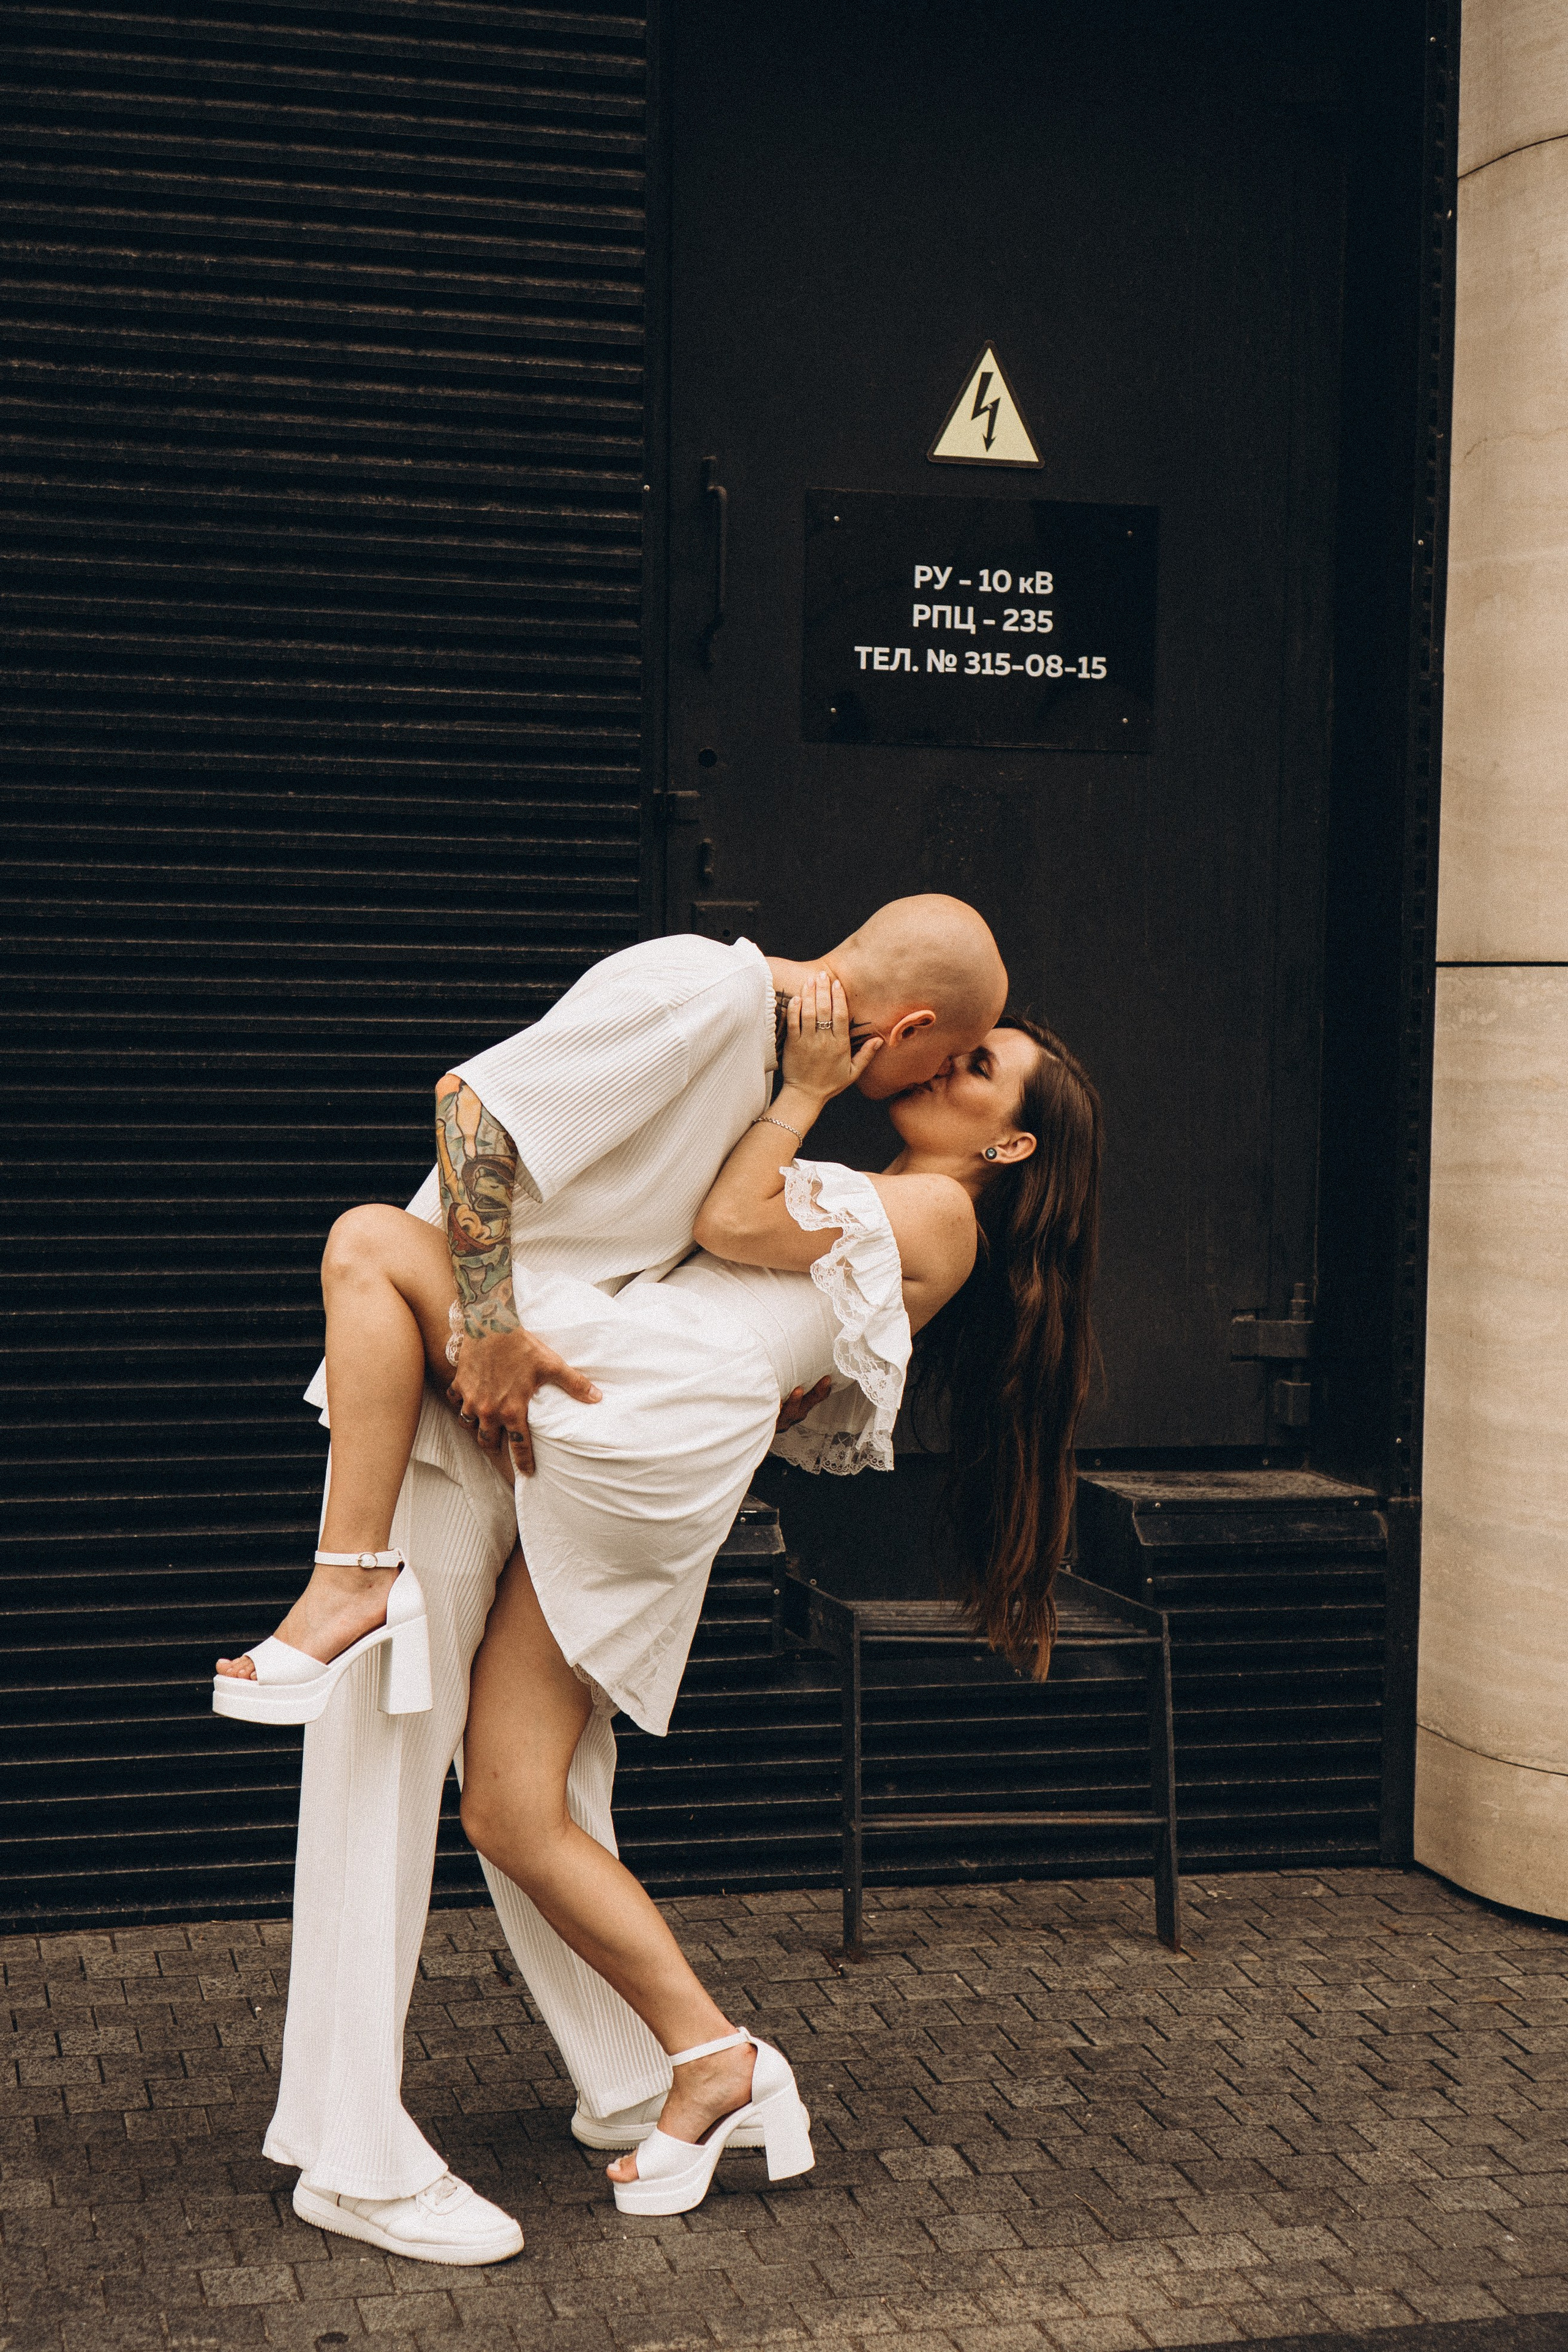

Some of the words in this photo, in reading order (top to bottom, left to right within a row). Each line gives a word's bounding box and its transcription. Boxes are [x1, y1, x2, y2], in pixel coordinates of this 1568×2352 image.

[914, 565, 953, 590] РУ
[978, 569, 1012, 593] 10
[1019, 571, 1054, 595] кВ
[913, 603, 976, 635] РПЦ
[1002, 609, 1054, 633] 235
[854, 646, 919, 672] ТЕЛ.
[927, 649, 957, 673] №
[964, 651, 1107, 679] 315-08-15
